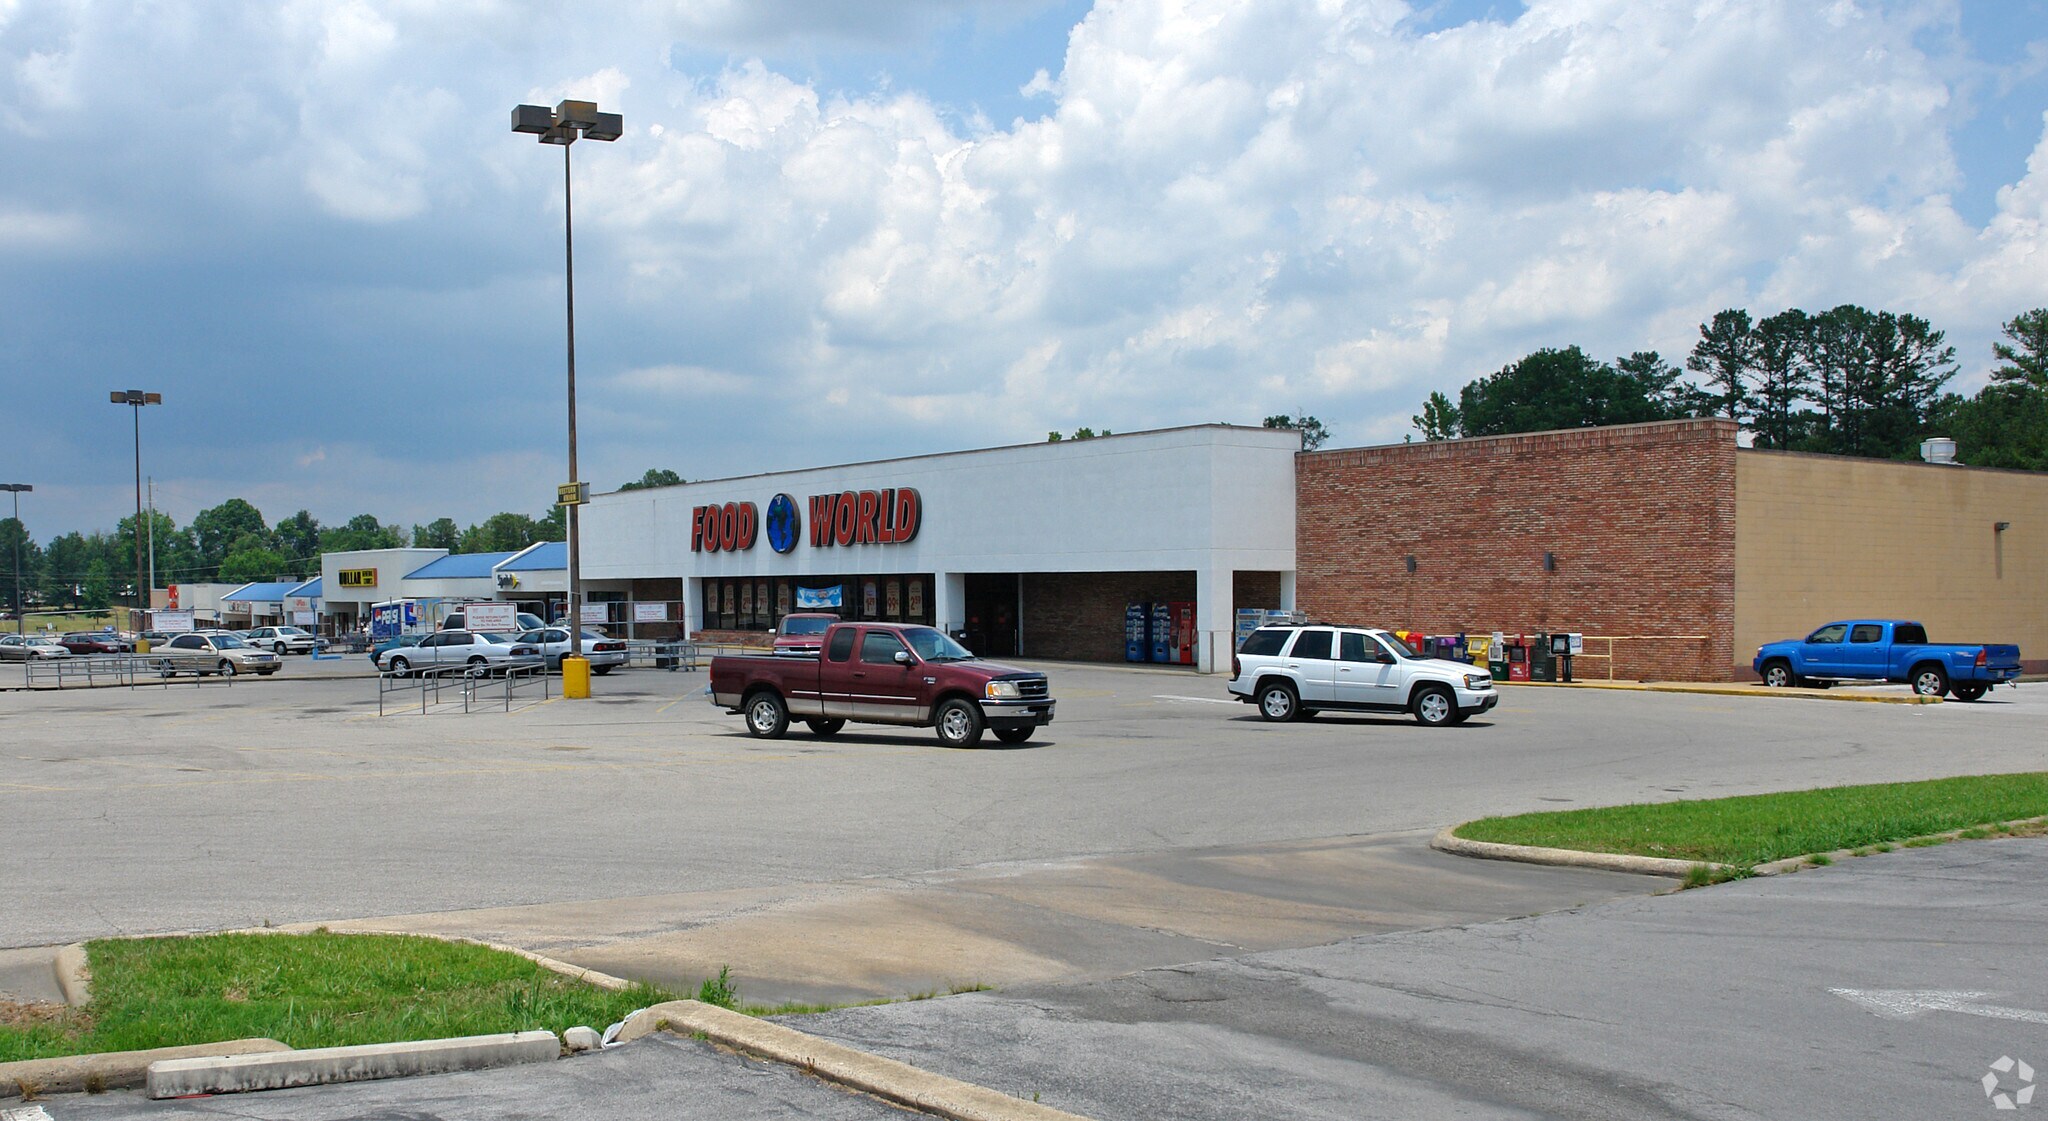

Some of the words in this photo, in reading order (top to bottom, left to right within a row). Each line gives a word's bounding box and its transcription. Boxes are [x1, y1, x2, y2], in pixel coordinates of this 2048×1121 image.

[691, 501, 758, 552] FOOD
[809, 487, 922, 547] WORLD
[339, 571, 361, 585] DOLLAR
